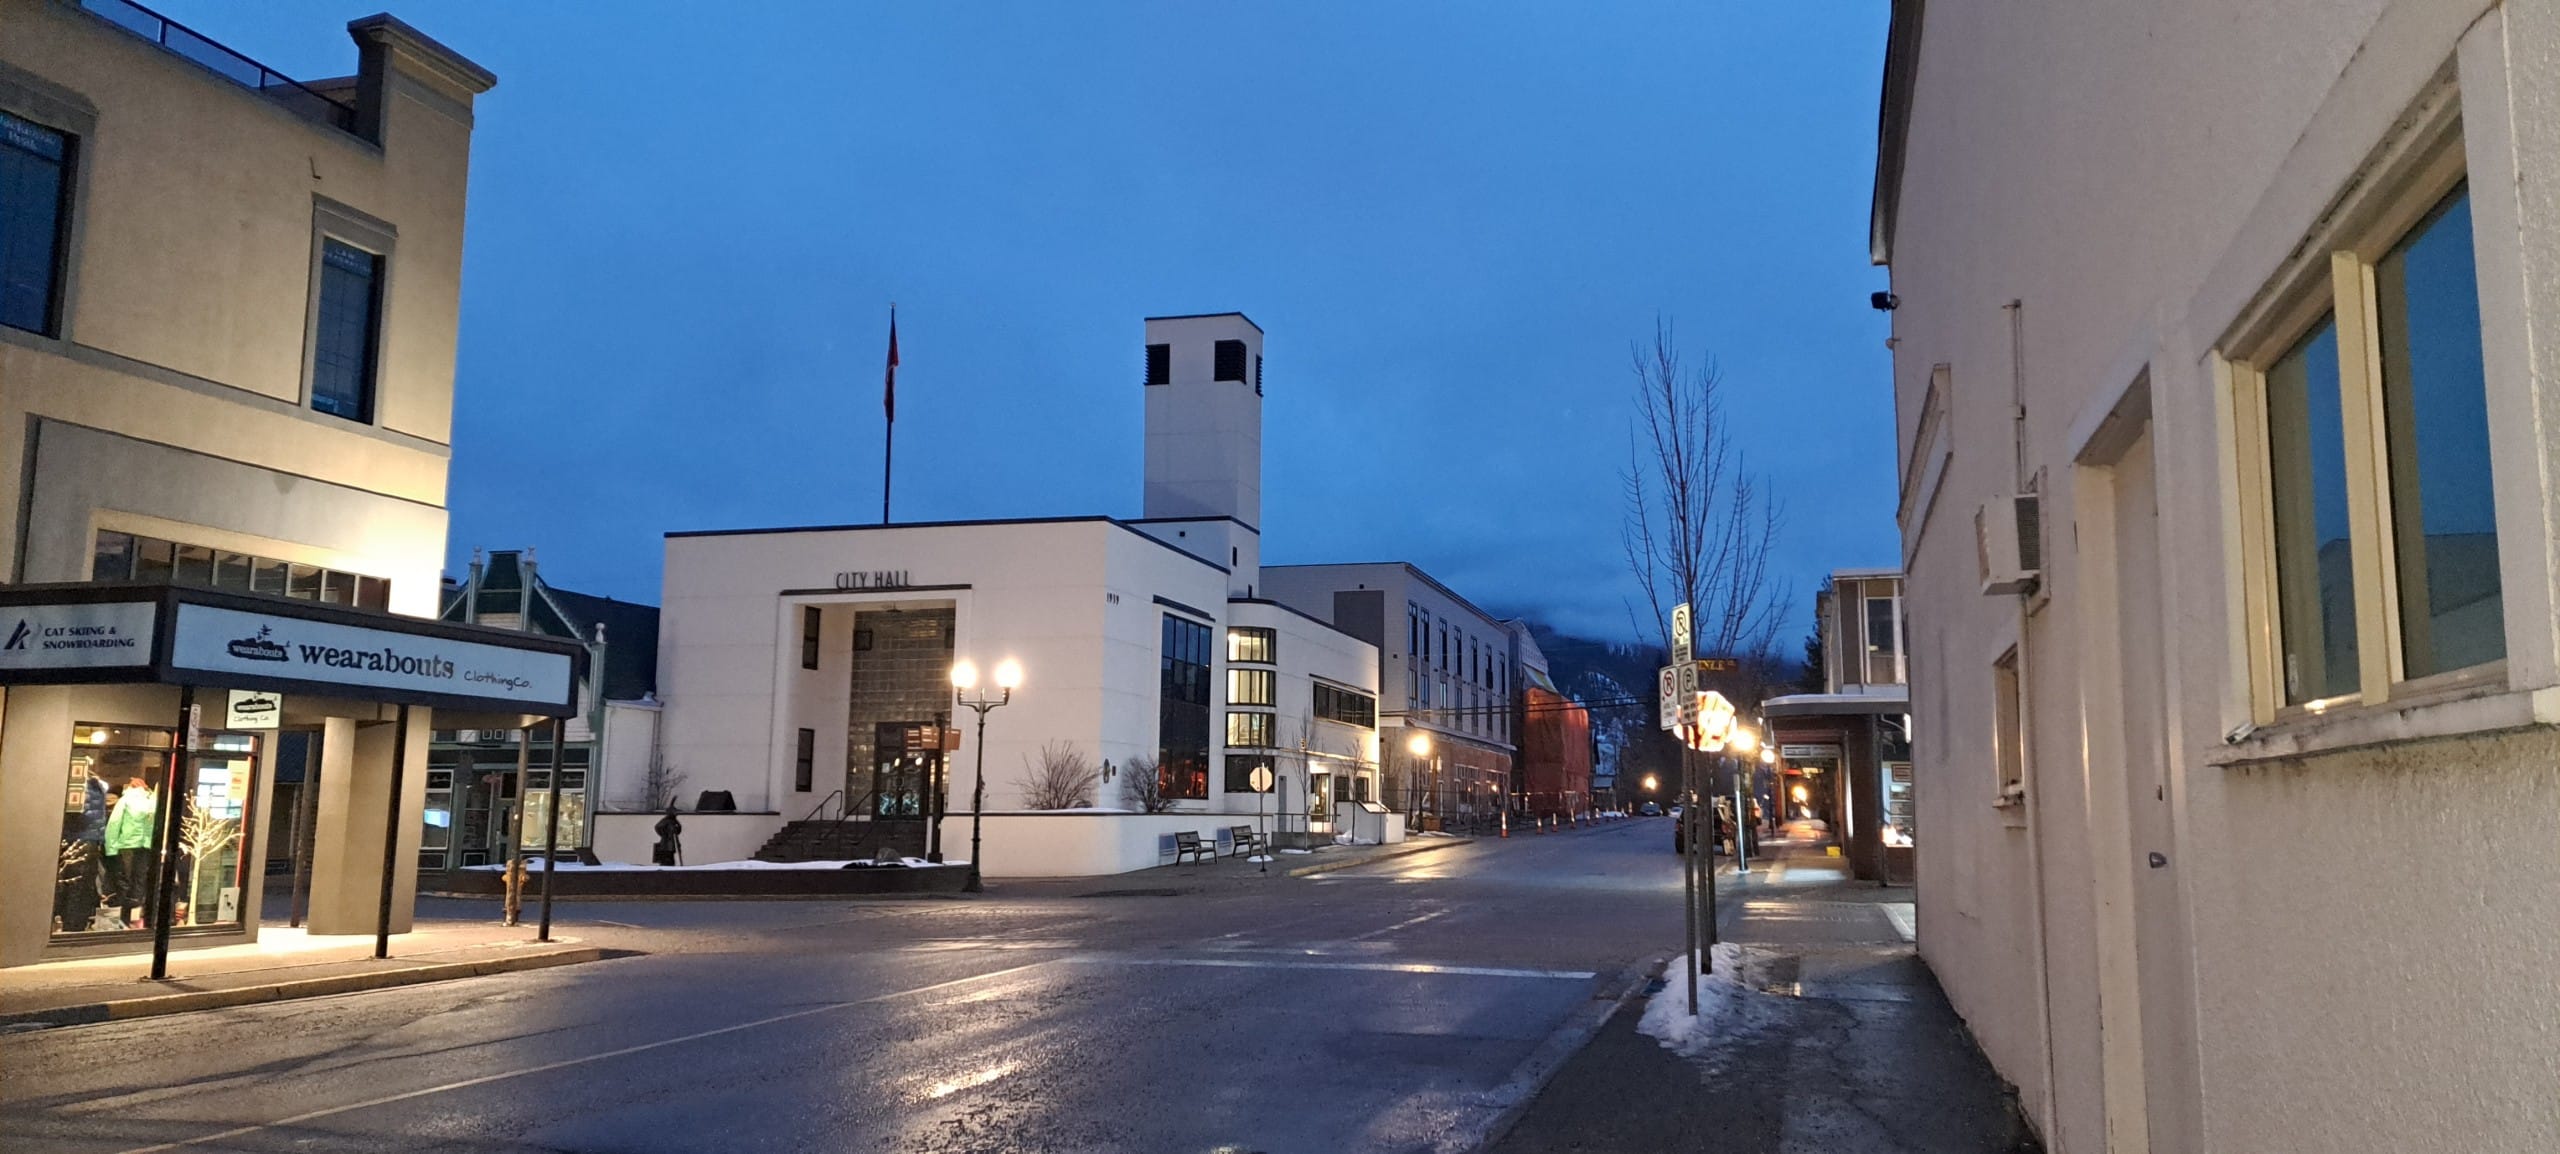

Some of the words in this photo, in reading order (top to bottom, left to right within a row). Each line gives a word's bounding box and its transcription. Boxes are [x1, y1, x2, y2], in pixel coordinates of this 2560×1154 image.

[836, 571, 868, 589] CITY
[875, 570, 911, 588] HALL
[44, 627, 66, 637] CAT
[68, 626, 105, 636] SKIING
[108, 626, 117, 635] &
[42, 638, 135, 650] SNOWBOARDING
[299, 644, 455, 679] wearabouts
